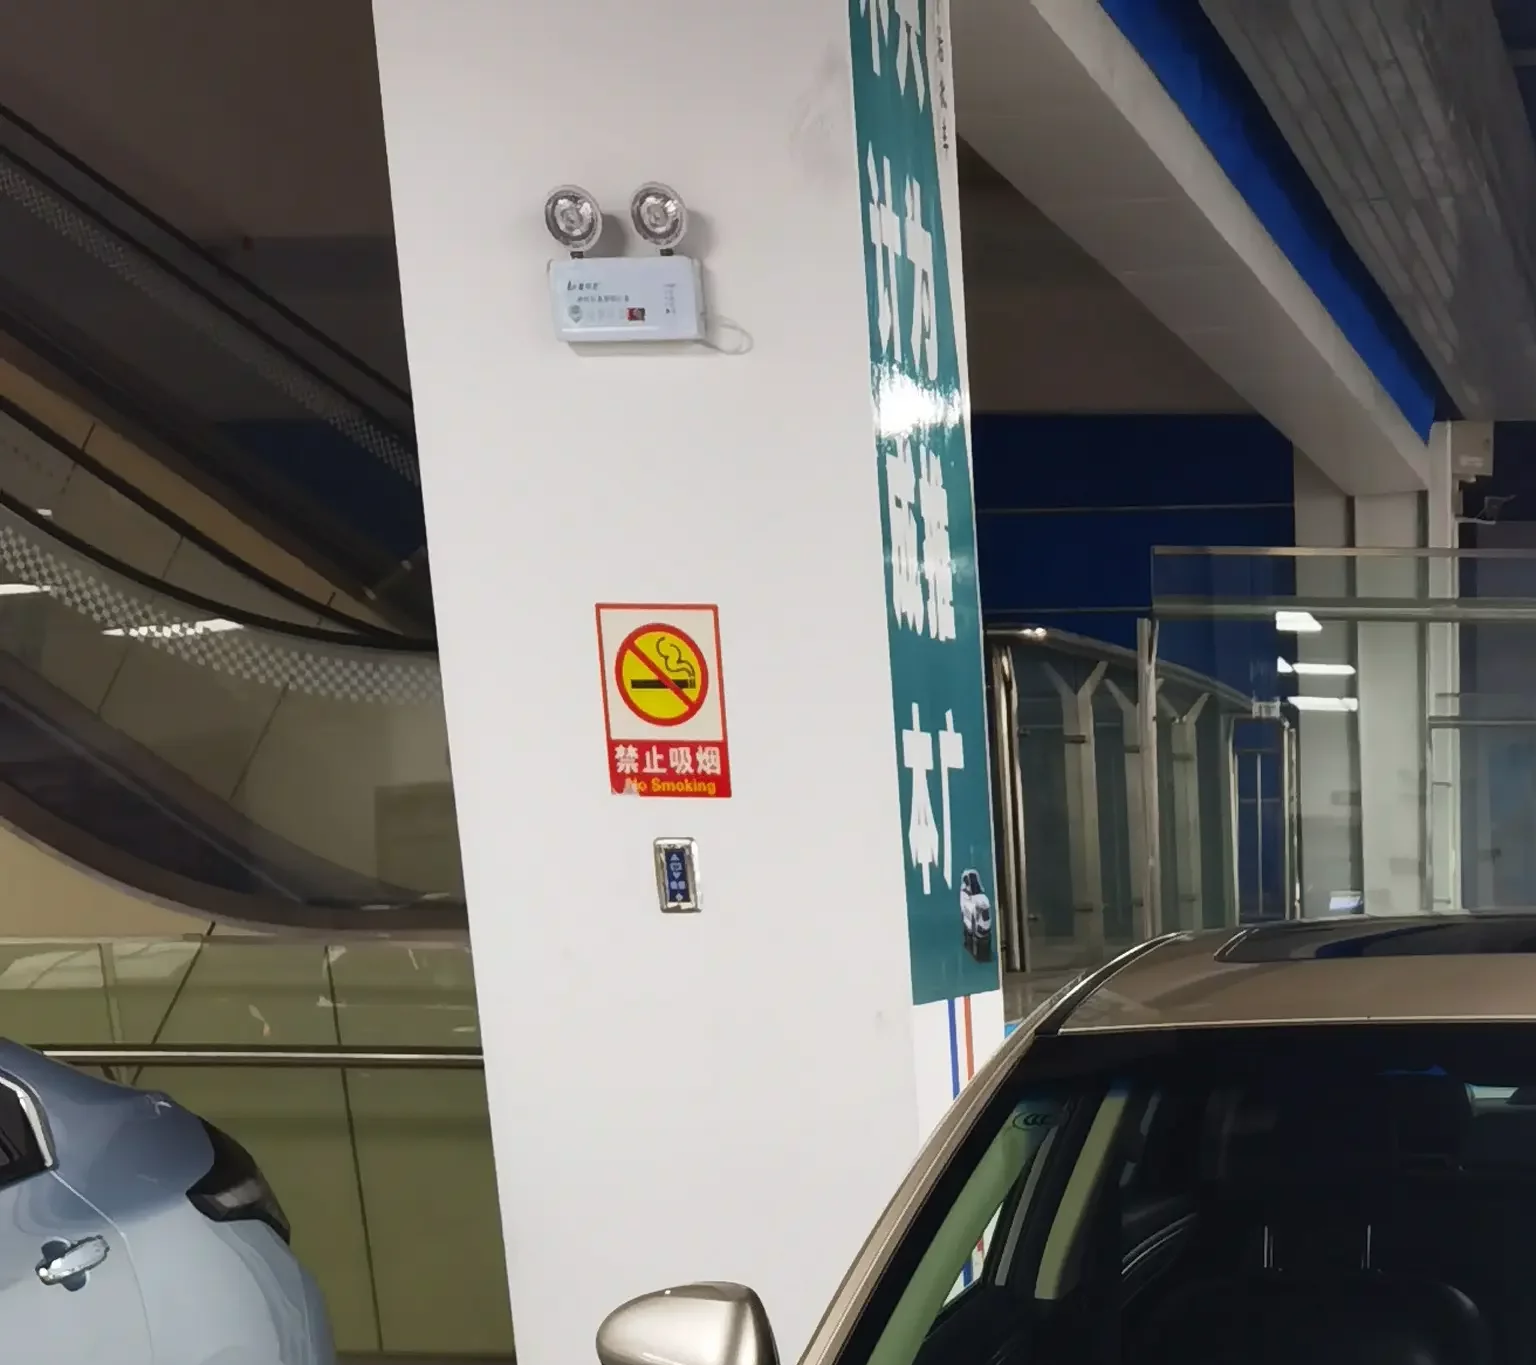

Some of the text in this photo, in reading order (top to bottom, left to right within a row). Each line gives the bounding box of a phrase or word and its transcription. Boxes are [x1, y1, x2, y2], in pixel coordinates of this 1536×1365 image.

[614, 744, 722, 776] 禁止吸烟
[650, 777, 717, 796] Smoking
